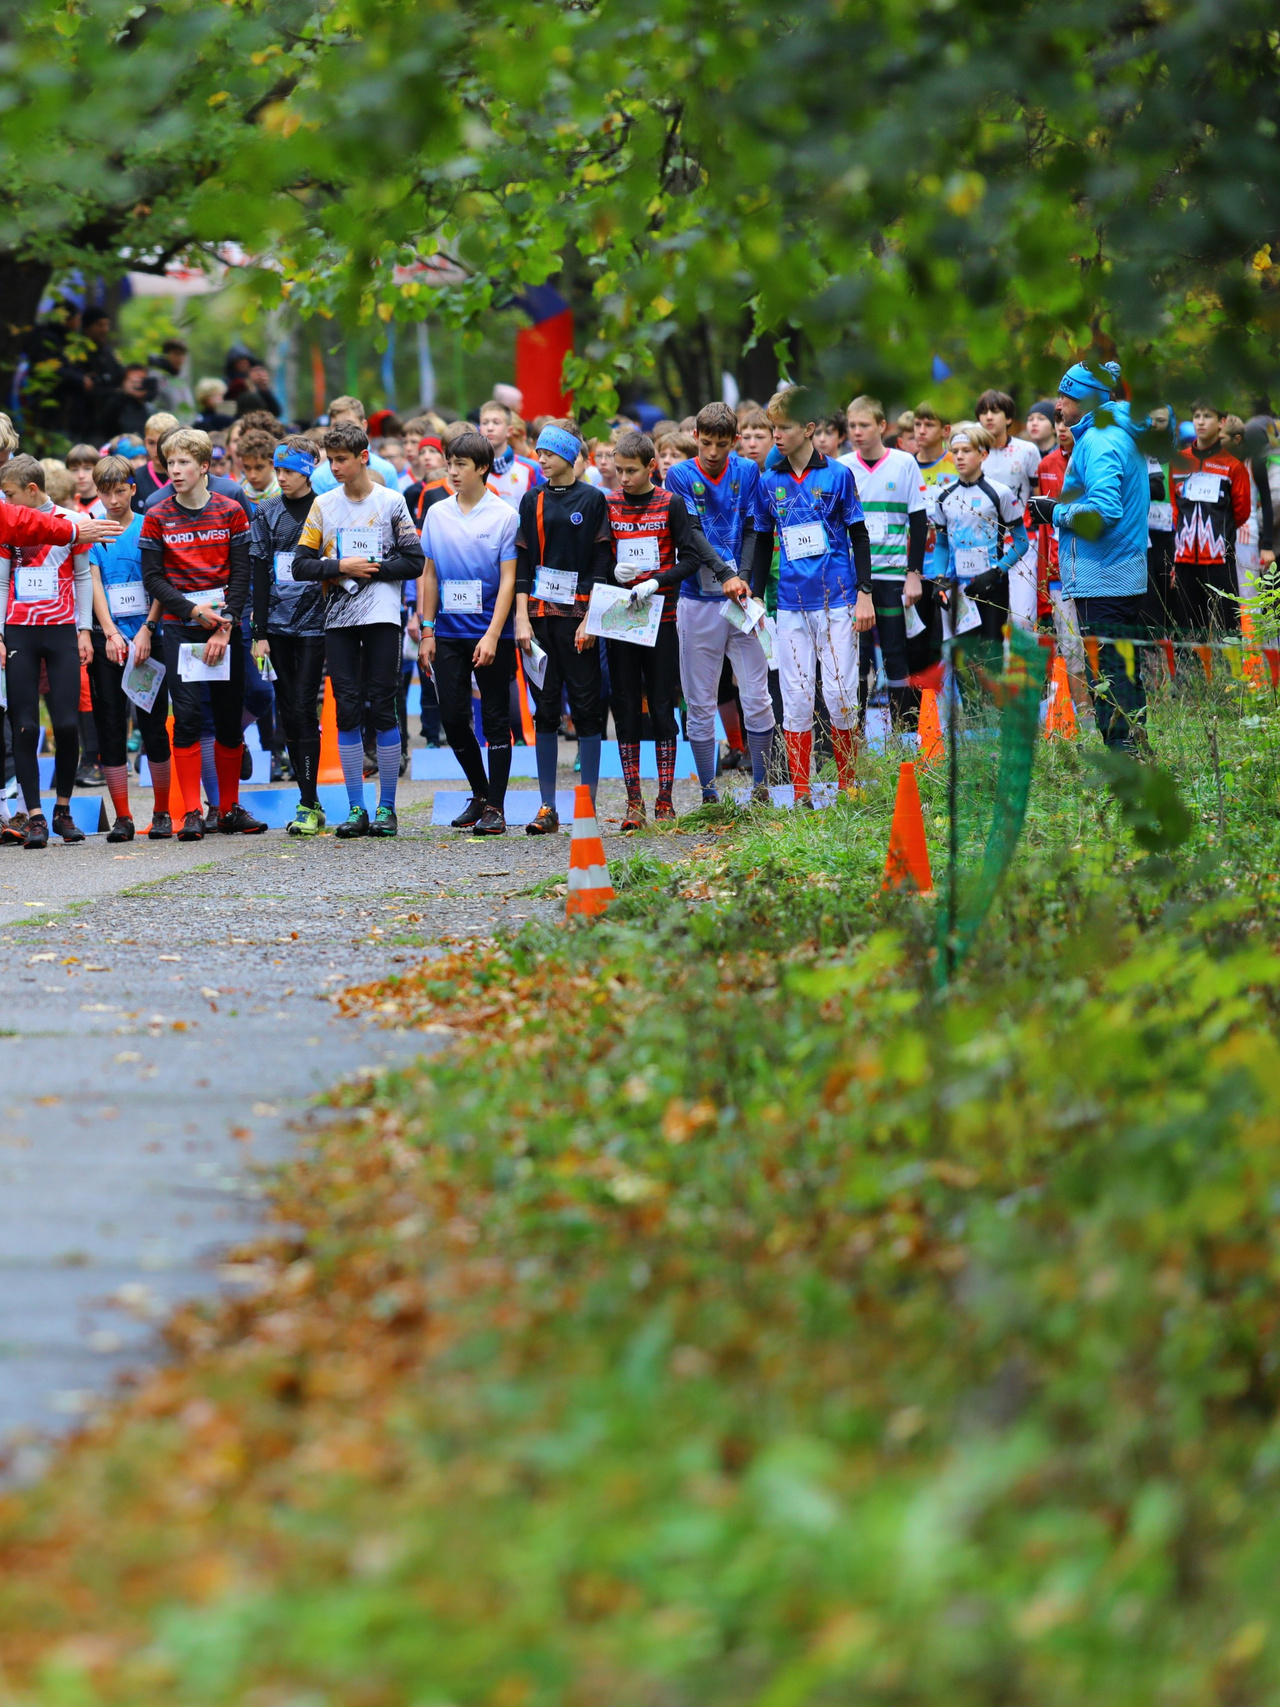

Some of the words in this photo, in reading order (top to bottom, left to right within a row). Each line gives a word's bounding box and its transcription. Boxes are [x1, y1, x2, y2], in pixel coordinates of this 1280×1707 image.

[637, 521, 667, 531] WEST
[162, 532, 194, 544] NORD
[197, 529, 231, 541] WEST
[798, 536, 812, 546] 201
[352, 541, 368, 549] 206
[629, 548, 644, 557] 203
[962, 561, 975, 569] 226
[27, 579, 43, 587] 212
[545, 581, 560, 591] 204
[120, 596, 136, 605] 209
[453, 593, 467, 601] 205
